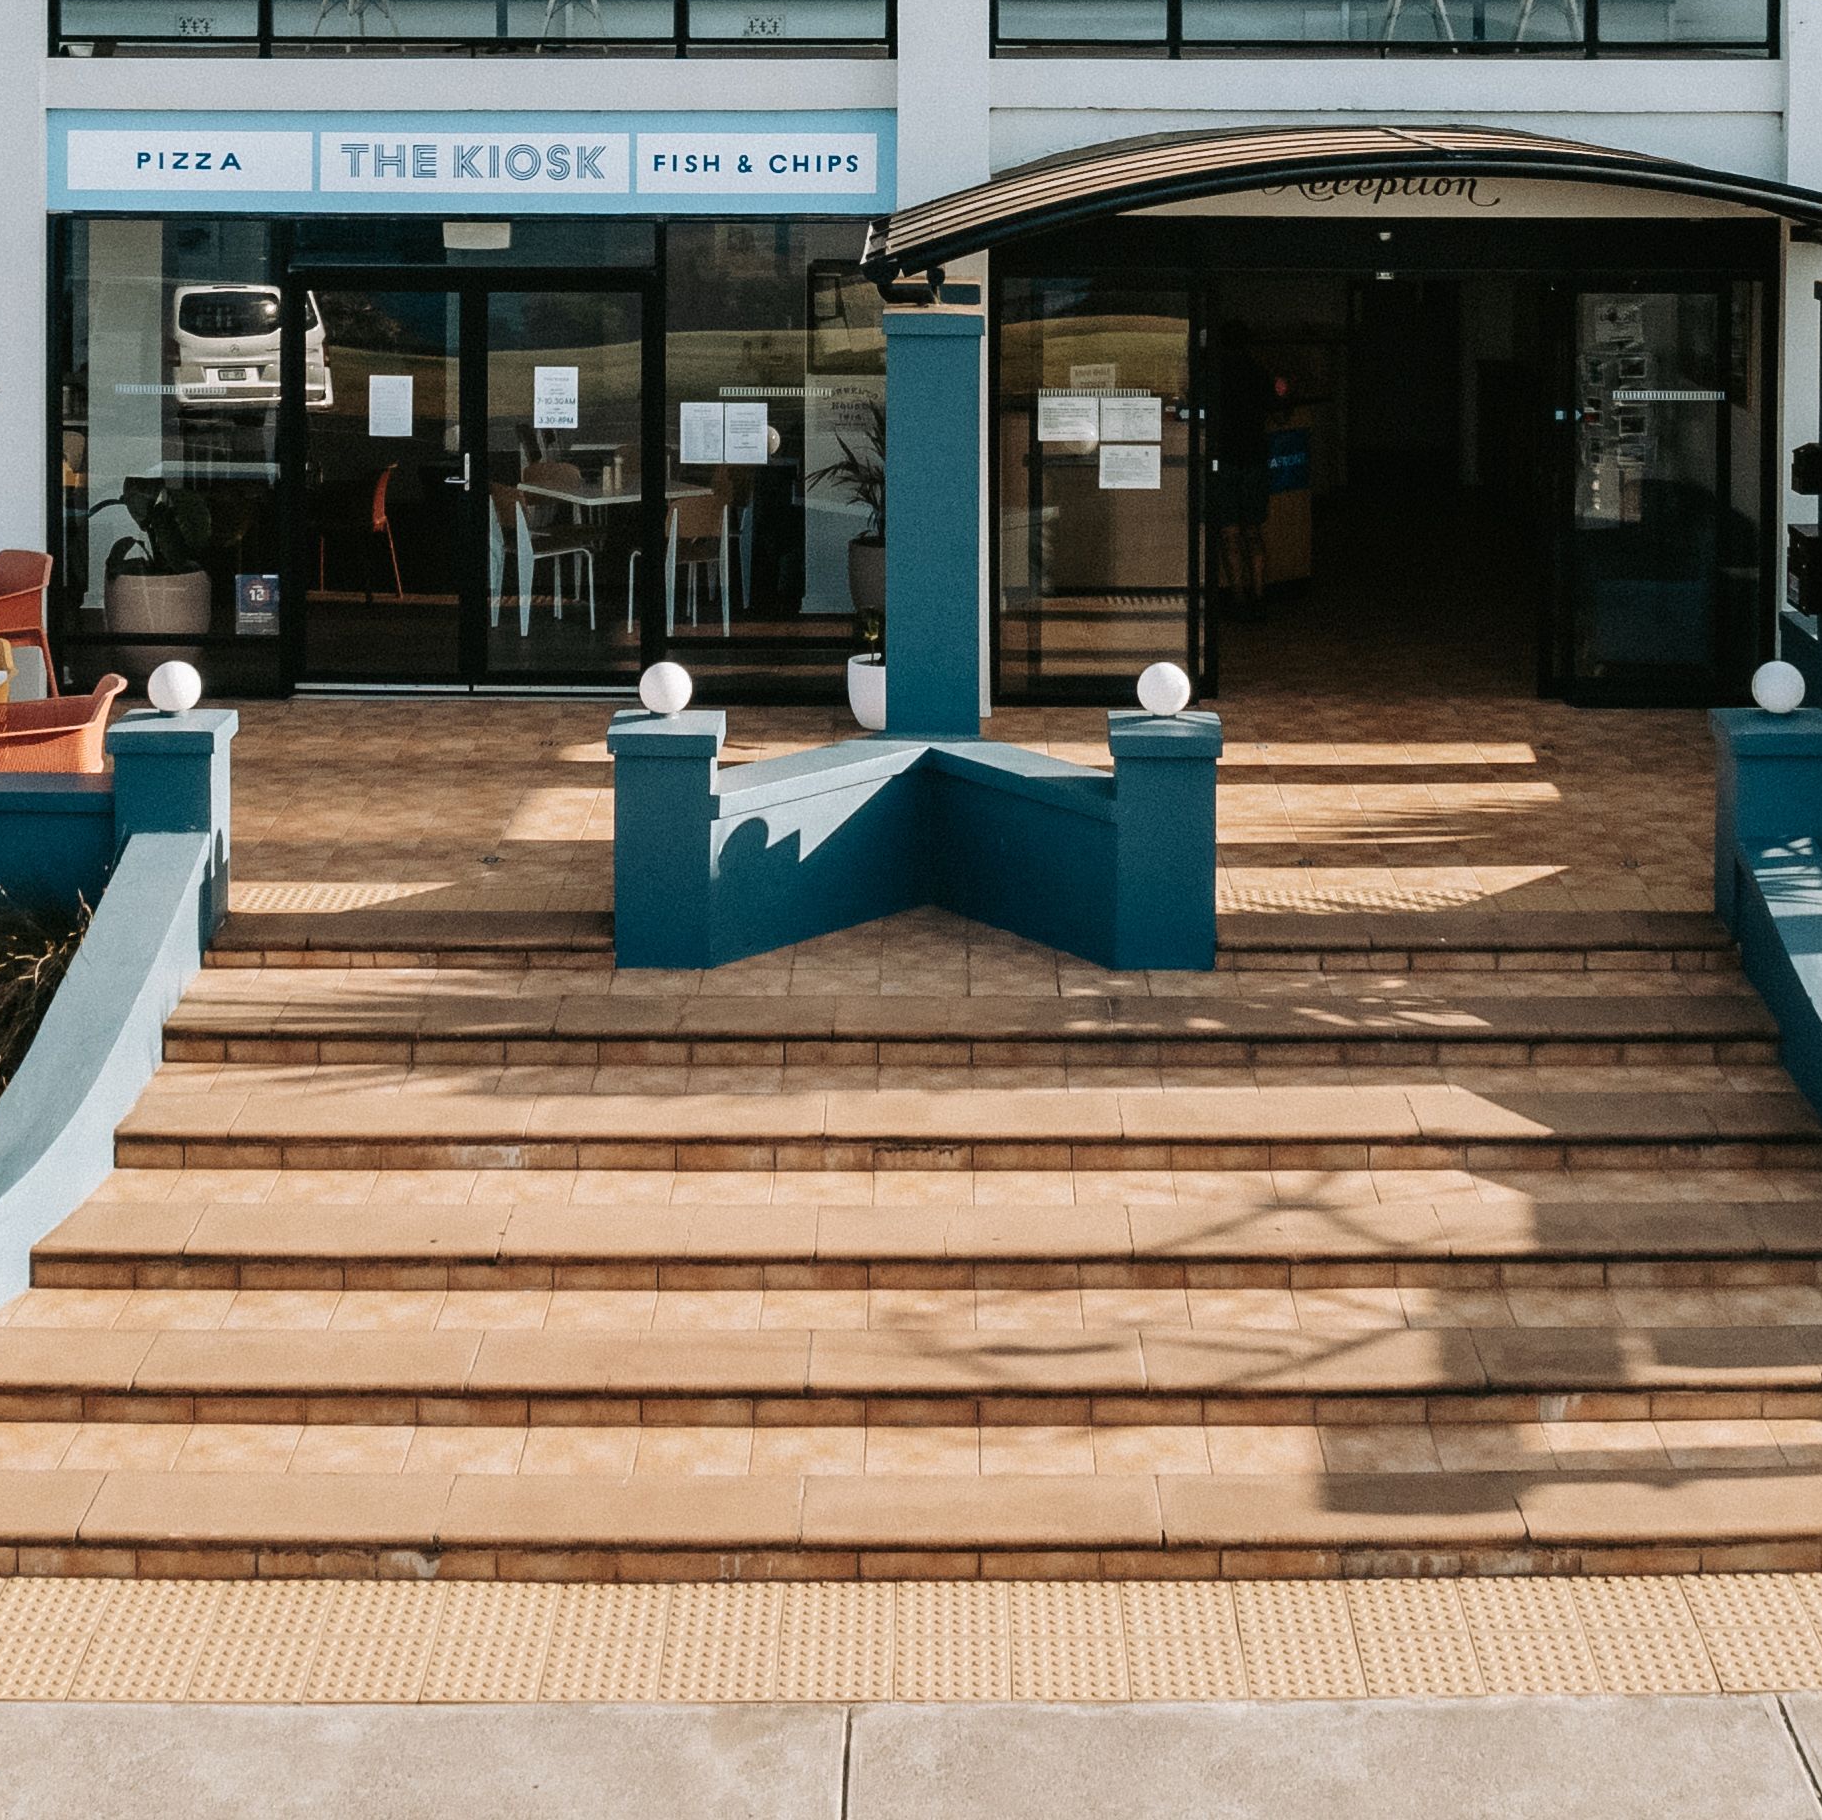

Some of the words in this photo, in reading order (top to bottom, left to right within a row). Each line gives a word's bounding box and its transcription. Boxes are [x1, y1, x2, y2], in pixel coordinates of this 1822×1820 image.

[136, 151, 243, 171] PIZZA
[340, 142, 438, 179] THE
[452, 143, 607, 182] KIOSK
[653, 154, 721, 174] FISH
[736, 154, 753, 174] &
[768, 153, 860, 175] CHIPS
